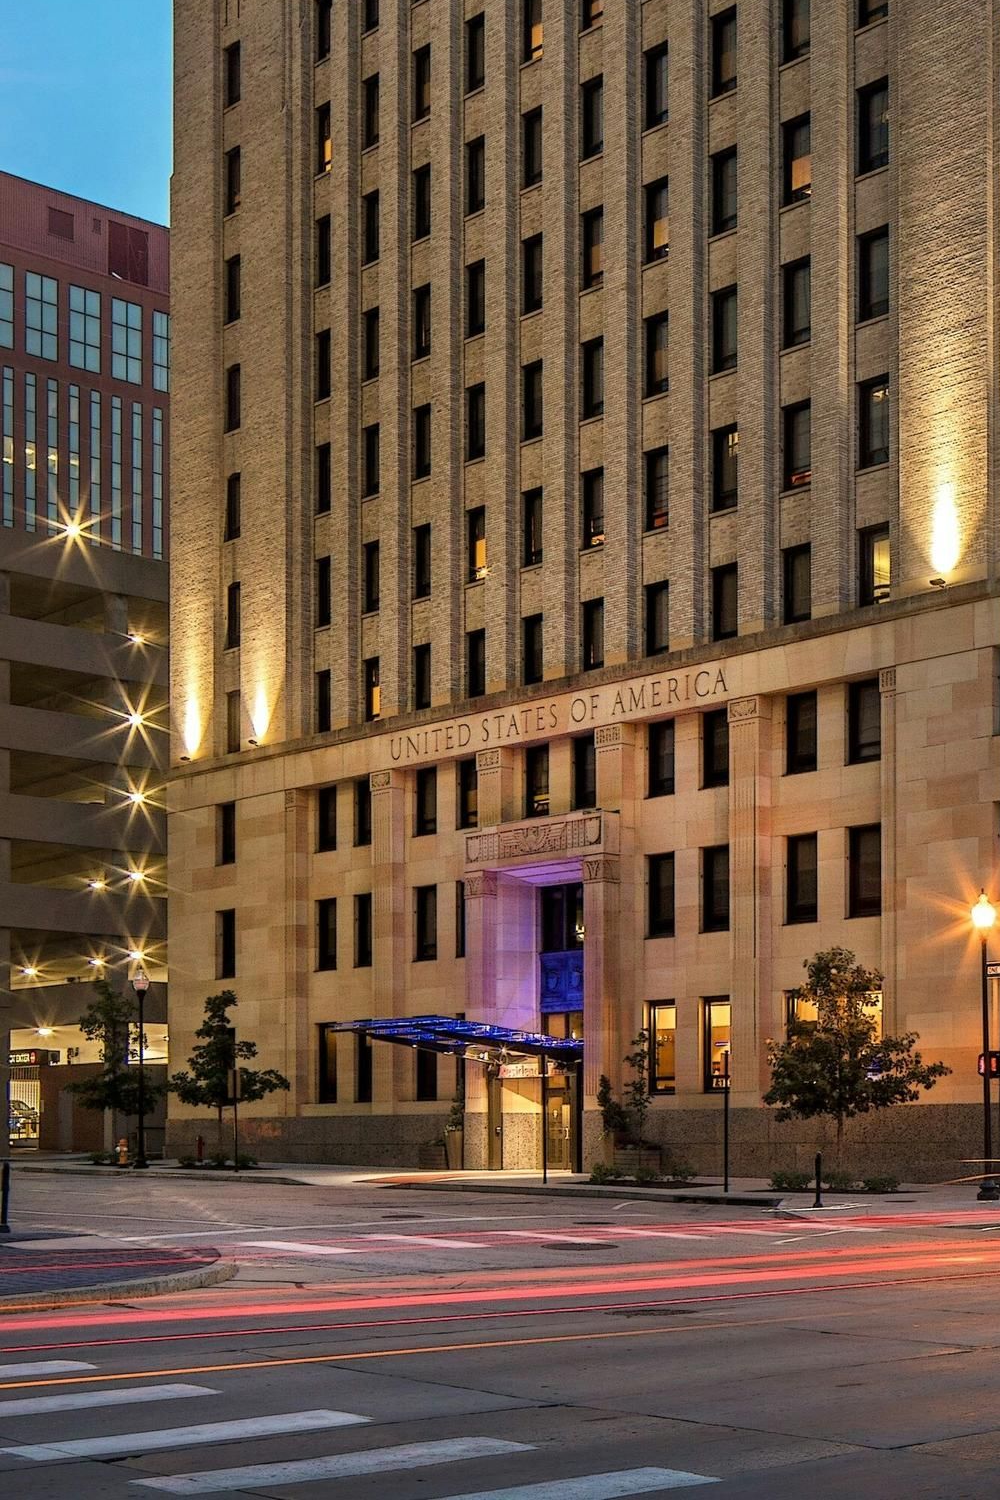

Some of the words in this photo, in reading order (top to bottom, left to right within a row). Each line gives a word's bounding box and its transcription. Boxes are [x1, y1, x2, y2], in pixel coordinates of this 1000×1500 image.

[390, 722, 472, 761] UNITED
[481, 702, 557, 743] STATES
[571, 693, 599, 723] OF
[611, 667, 729, 716] AMERICA
